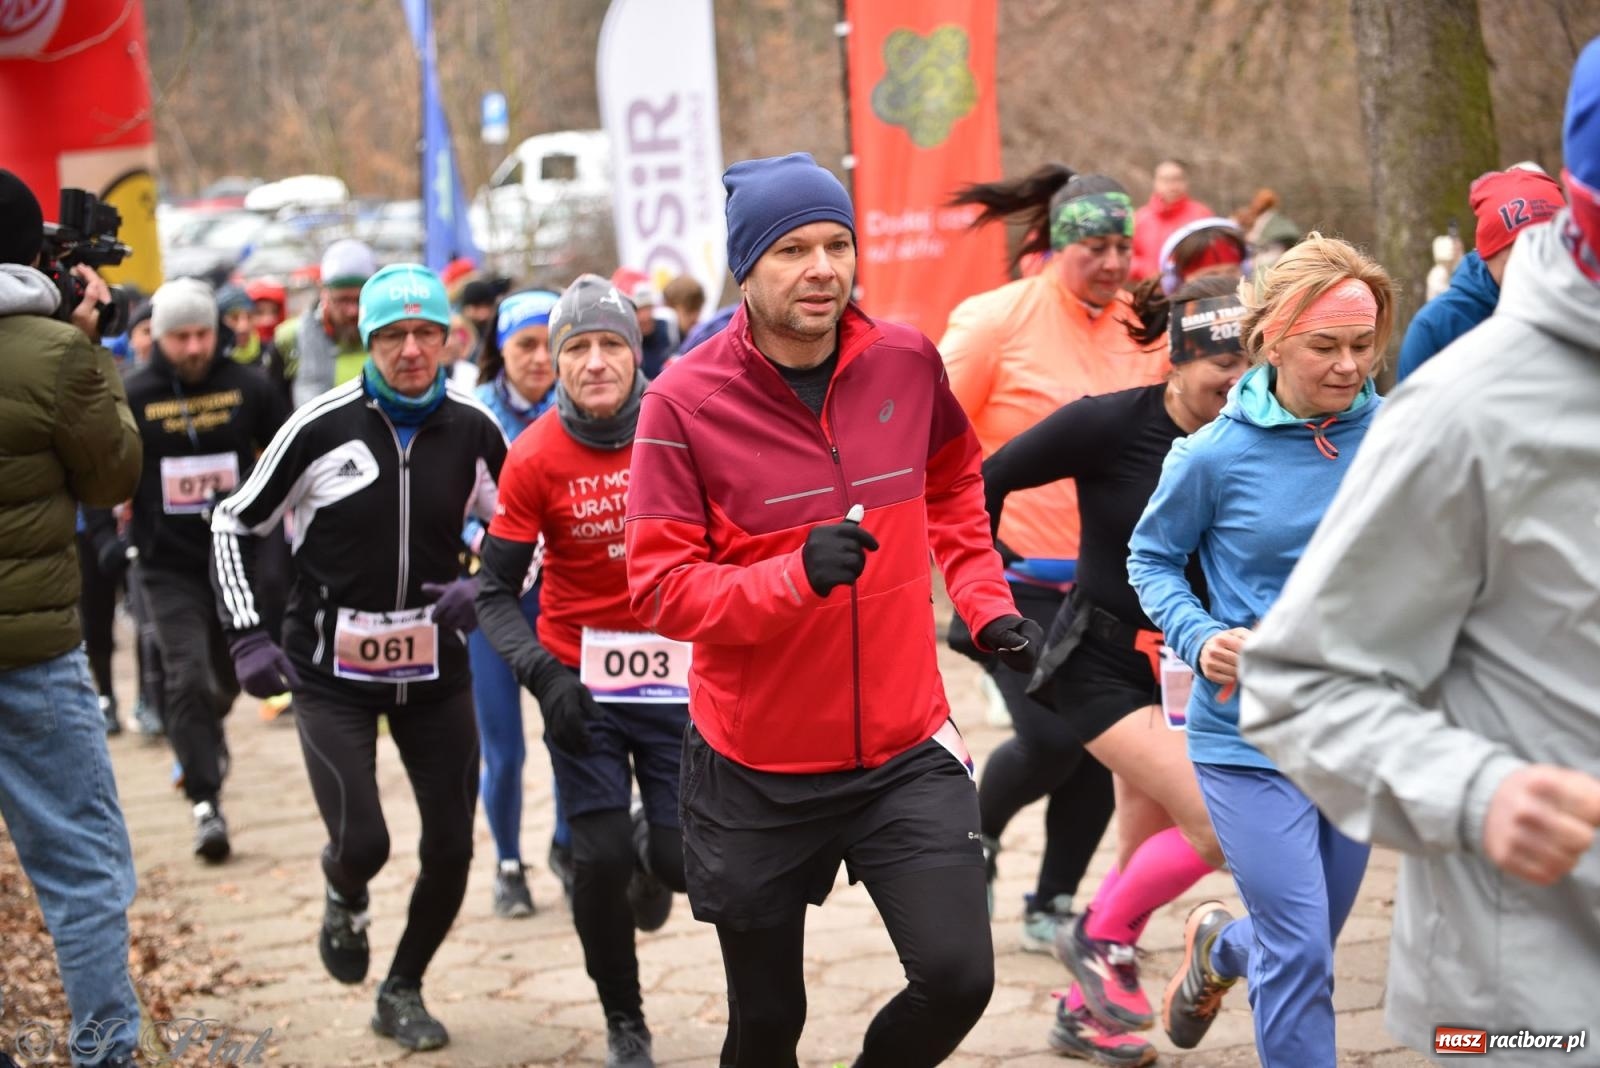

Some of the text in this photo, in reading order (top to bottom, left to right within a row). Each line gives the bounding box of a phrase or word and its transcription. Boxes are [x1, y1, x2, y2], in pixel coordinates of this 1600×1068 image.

[1499, 199, 1530, 231] 12
[568, 480, 576, 497] I
[576, 475, 600, 495] TY
[360, 636, 415, 662] 061
[604, 650, 670, 678] 003
